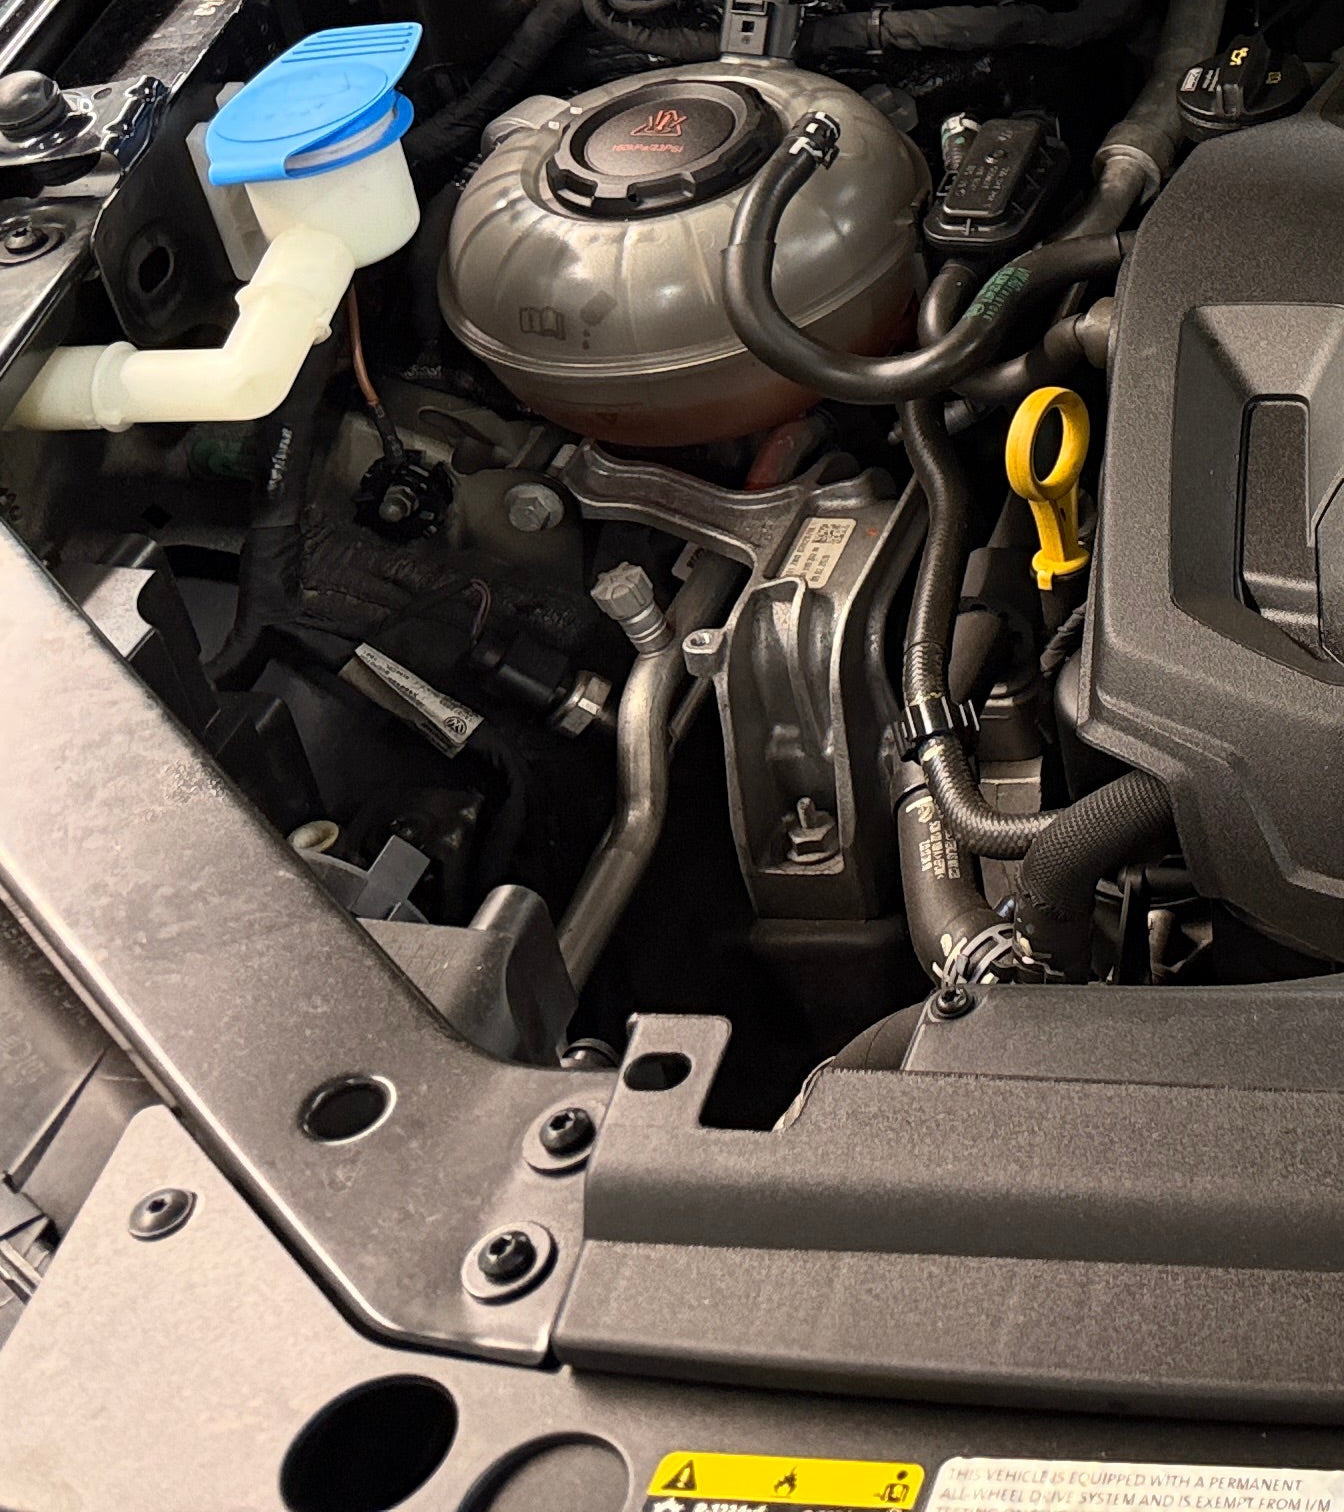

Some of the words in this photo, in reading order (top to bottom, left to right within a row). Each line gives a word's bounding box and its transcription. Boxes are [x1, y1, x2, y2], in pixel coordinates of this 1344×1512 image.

[949, 1468, 981, 1481] THIS
[987, 1469, 1048, 1483] VEHICLE
[1050, 1471, 1065, 1483] IS
[1069, 1471, 1146, 1487] EQUIPPED
[1150, 1474, 1190, 1487] WITH
[1193, 1476, 1205, 1488] A
[1208, 1477, 1303, 1492] PERMANENT
[1080, 1492, 1136, 1506] SYSTEM
[1138, 1493, 1174, 1507] AND
[1178, 1495, 1191, 1507] IS
[1195, 1495, 1254, 1509] EXEMPT
[1258, 1498, 1301, 1511] FROM
[1305, 1499, 1331, 1512] I/M
